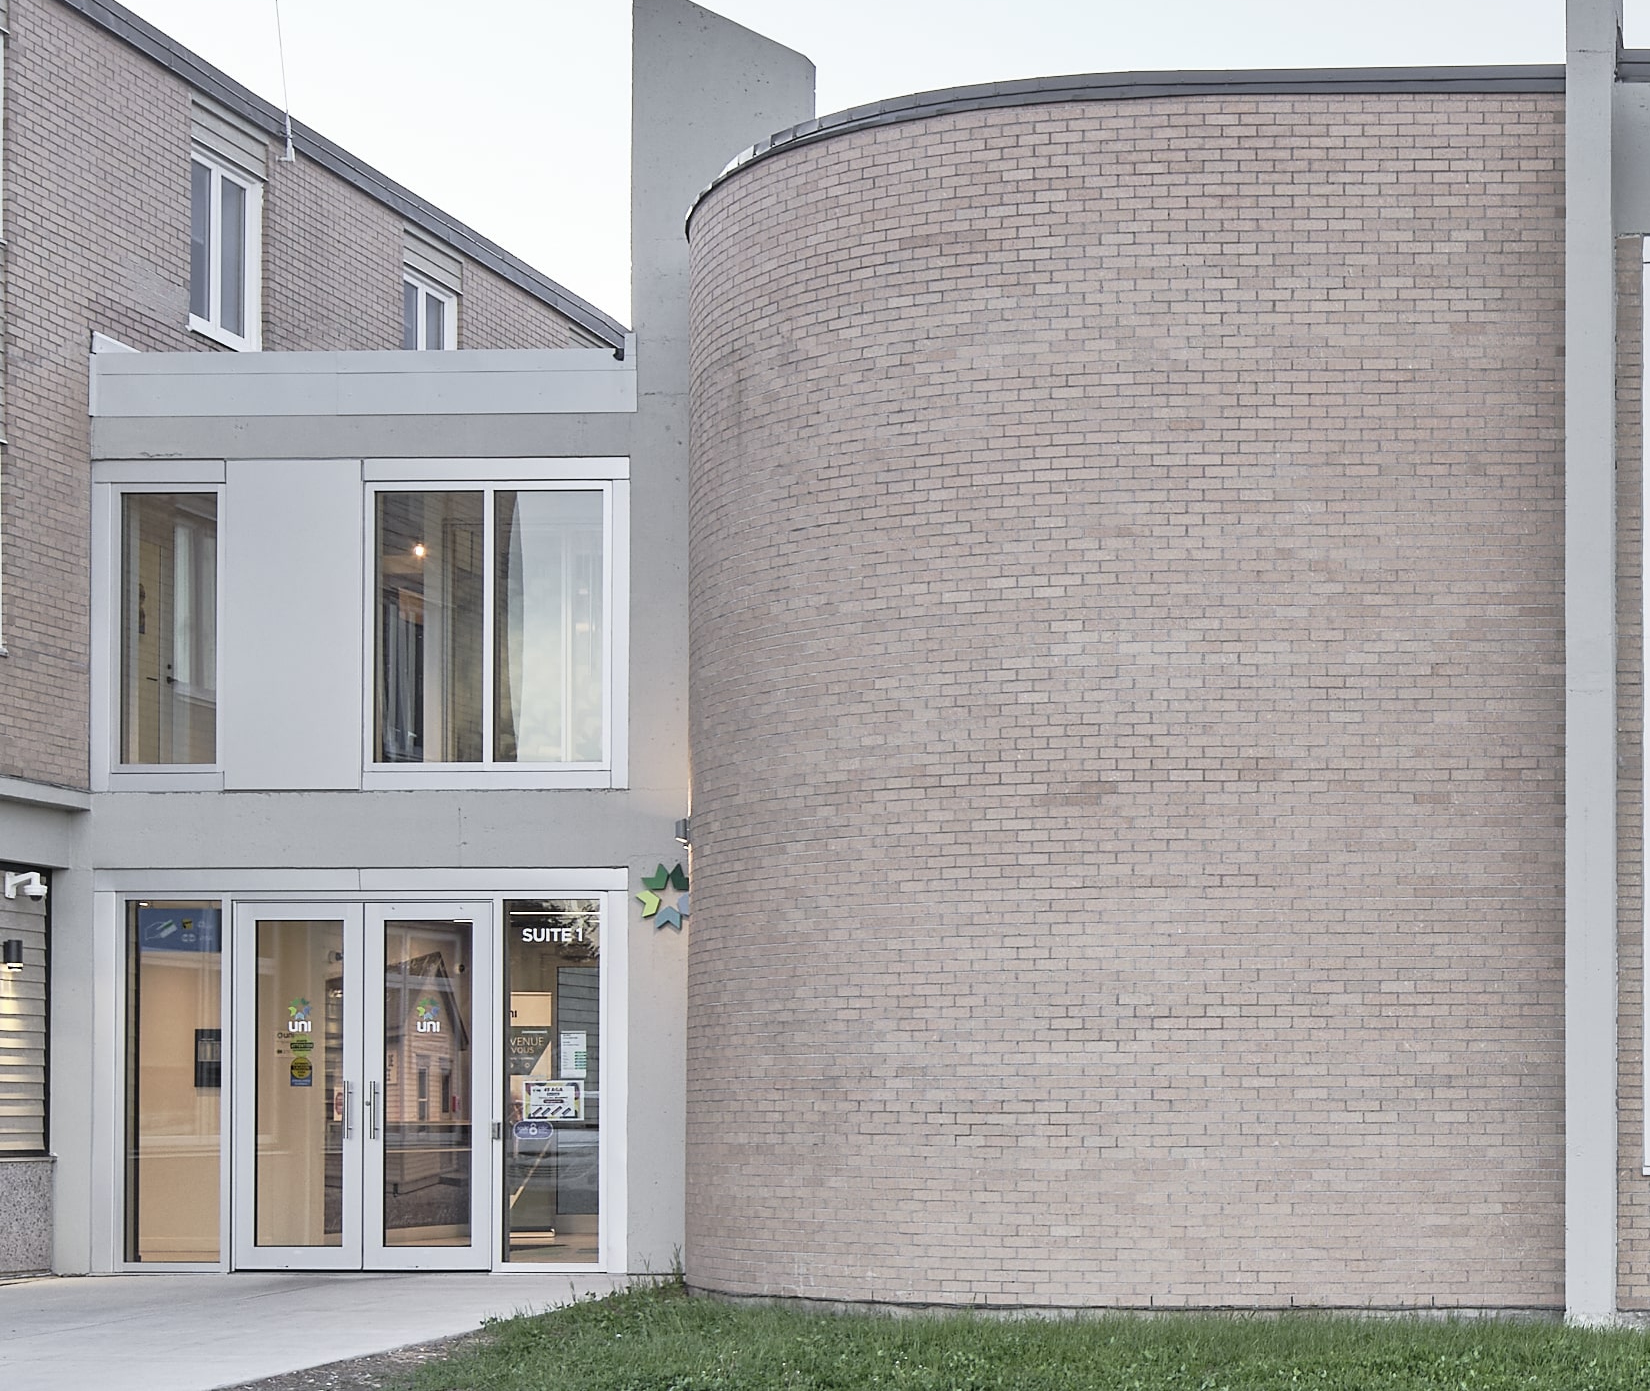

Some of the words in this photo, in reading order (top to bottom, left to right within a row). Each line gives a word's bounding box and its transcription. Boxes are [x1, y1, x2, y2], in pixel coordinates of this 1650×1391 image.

[522, 928, 572, 942] SUITE
[576, 927, 583, 942] 1
[288, 1020, 312, 1032] uni
[416, 1021, 440, 1033] uni
